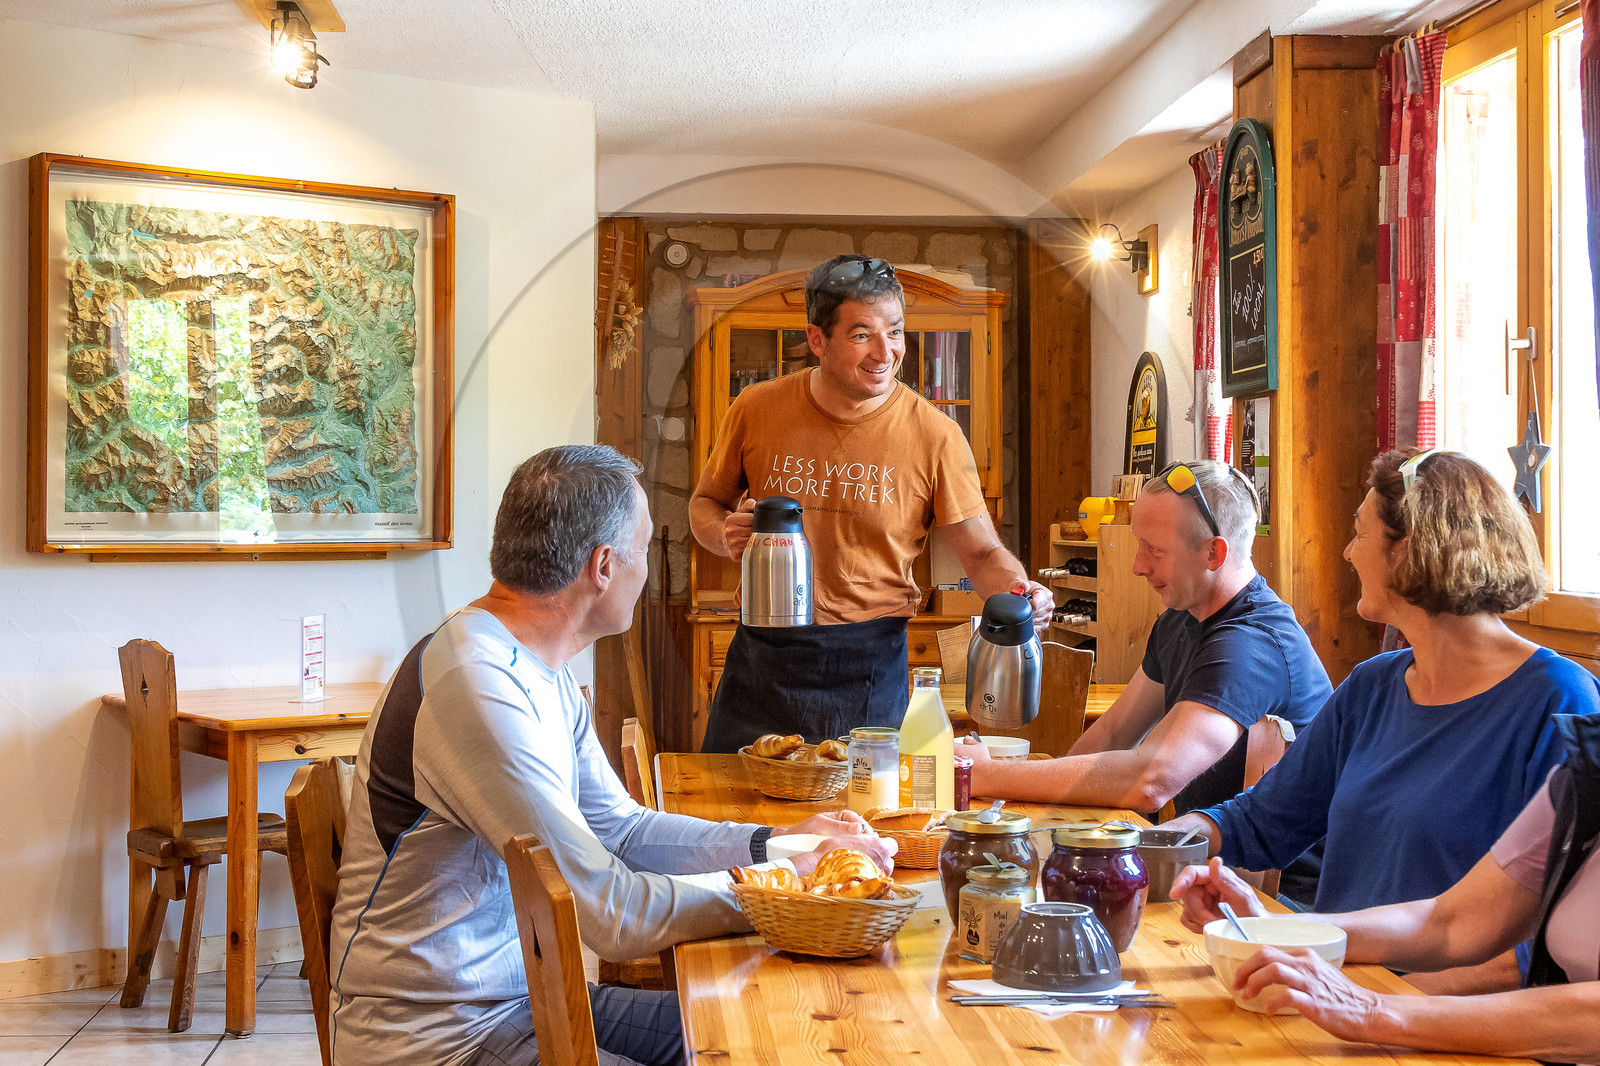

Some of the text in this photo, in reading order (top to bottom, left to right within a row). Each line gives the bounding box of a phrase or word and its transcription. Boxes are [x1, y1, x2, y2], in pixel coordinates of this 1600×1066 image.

[772, 454, 897, 483] LESS WORK
[763, 474, 896, 504] MORE TREK
[993, 910, 1008, 920] Miel
